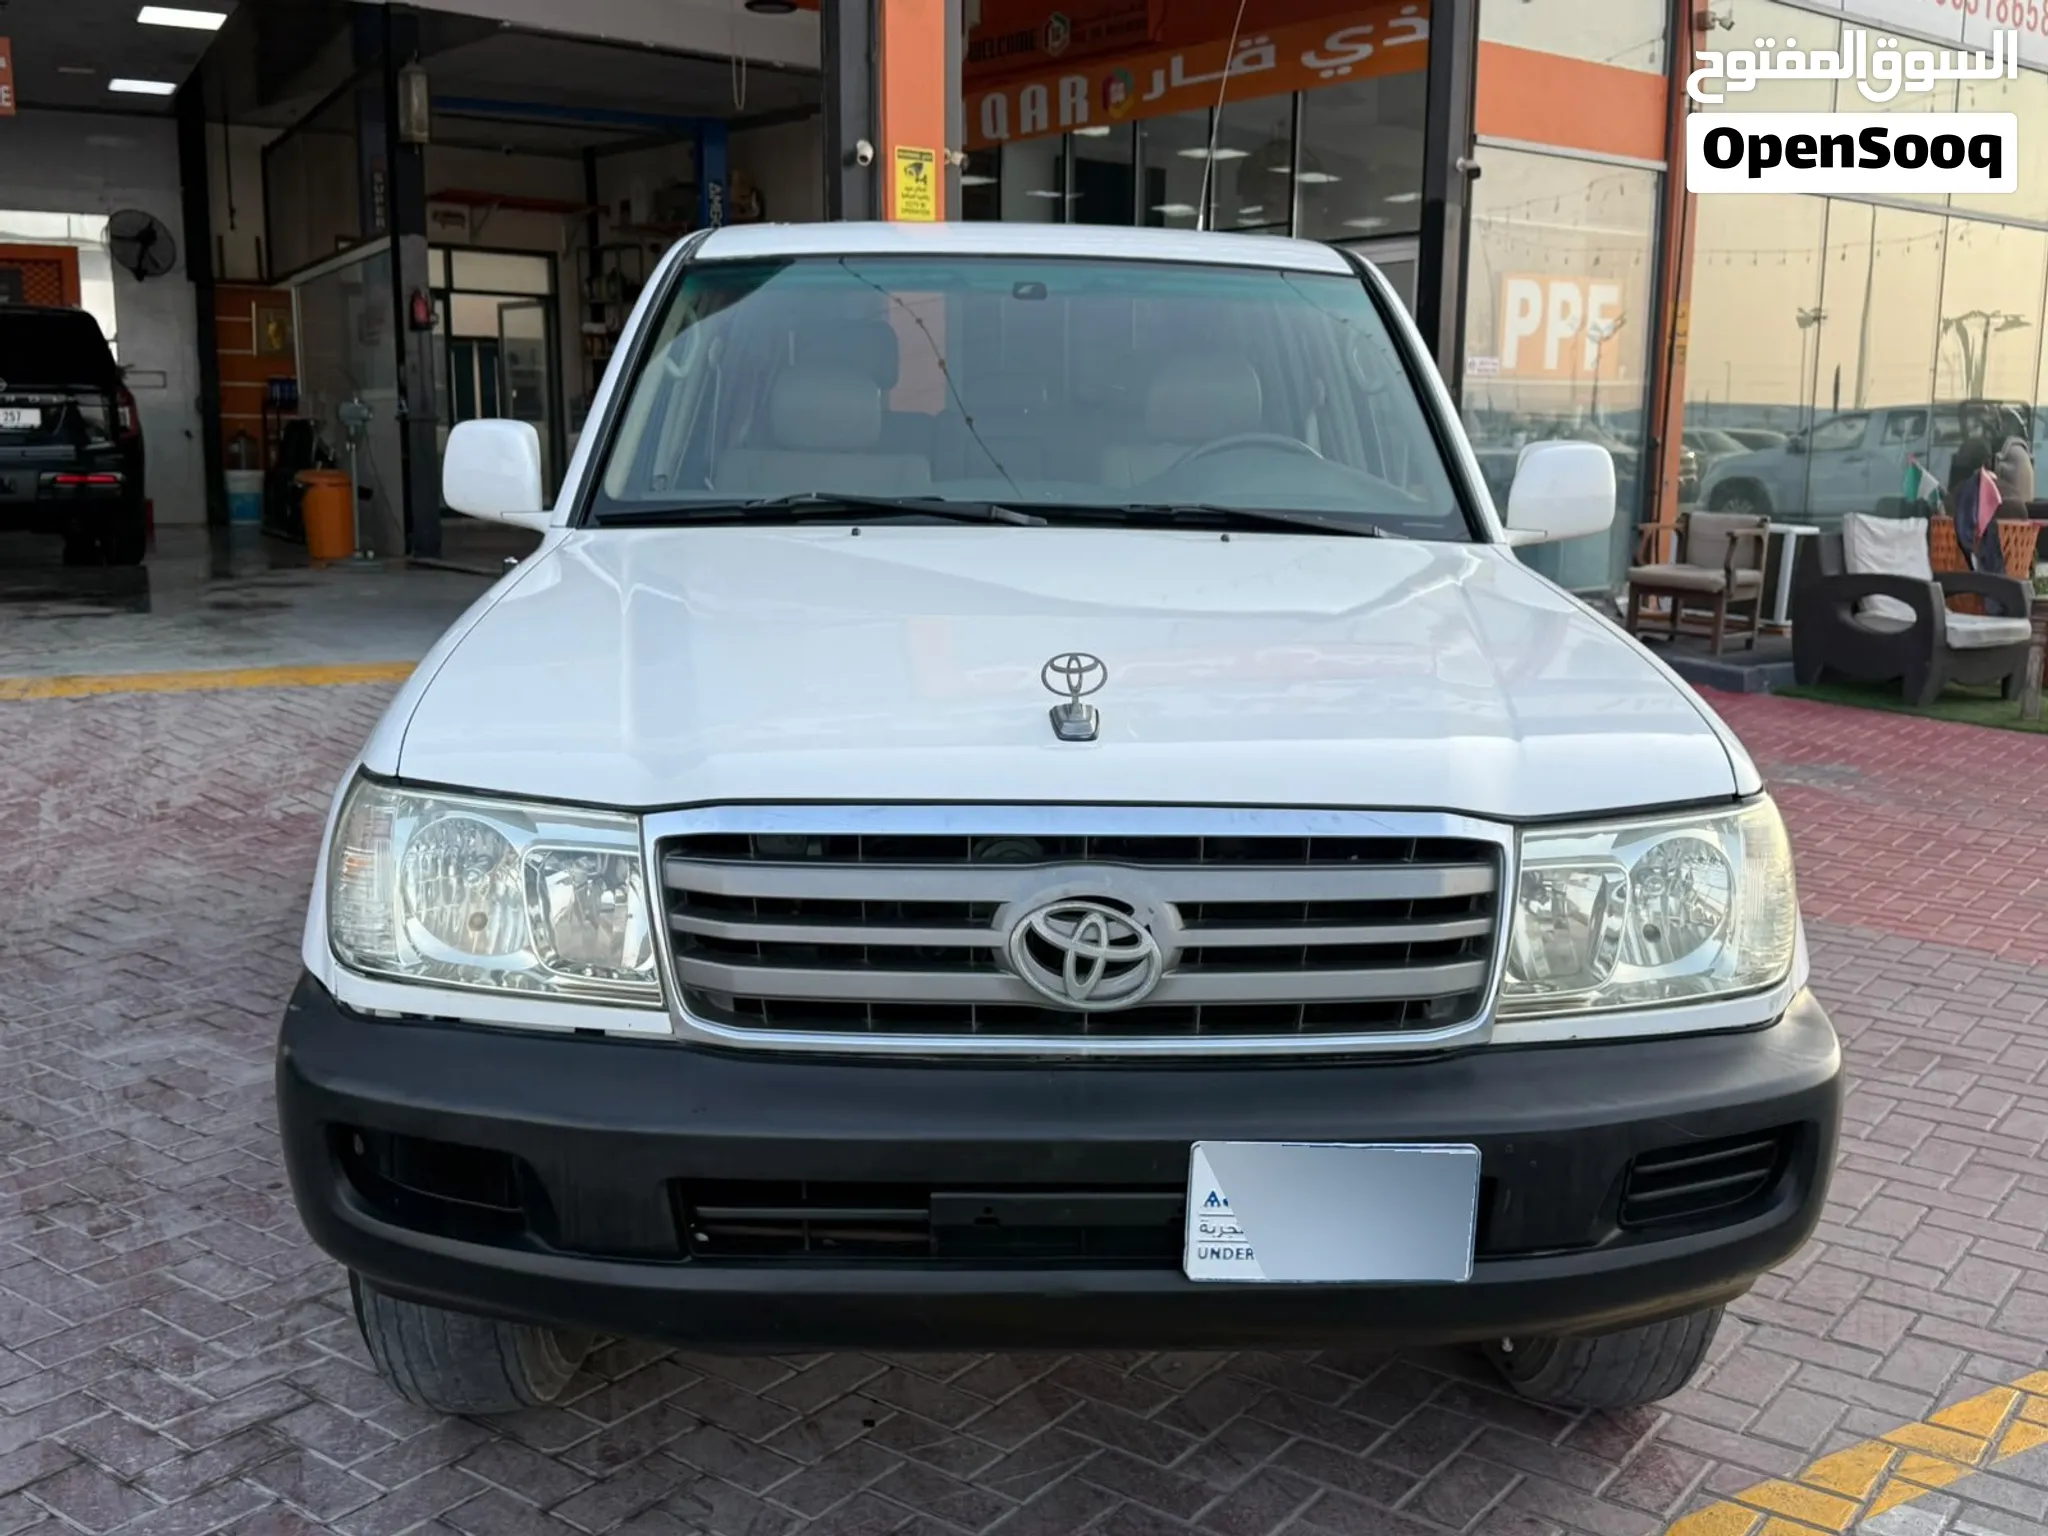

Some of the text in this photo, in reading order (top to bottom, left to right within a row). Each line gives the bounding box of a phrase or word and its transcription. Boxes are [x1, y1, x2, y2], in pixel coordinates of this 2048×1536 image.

[1142, 5, 1428, 101] ذي قار
[981, 75, 1089, 140] QAR
[1501, 278, 1620, 371] PPF
[1197, 1247, 1255, 1261] UNDER
